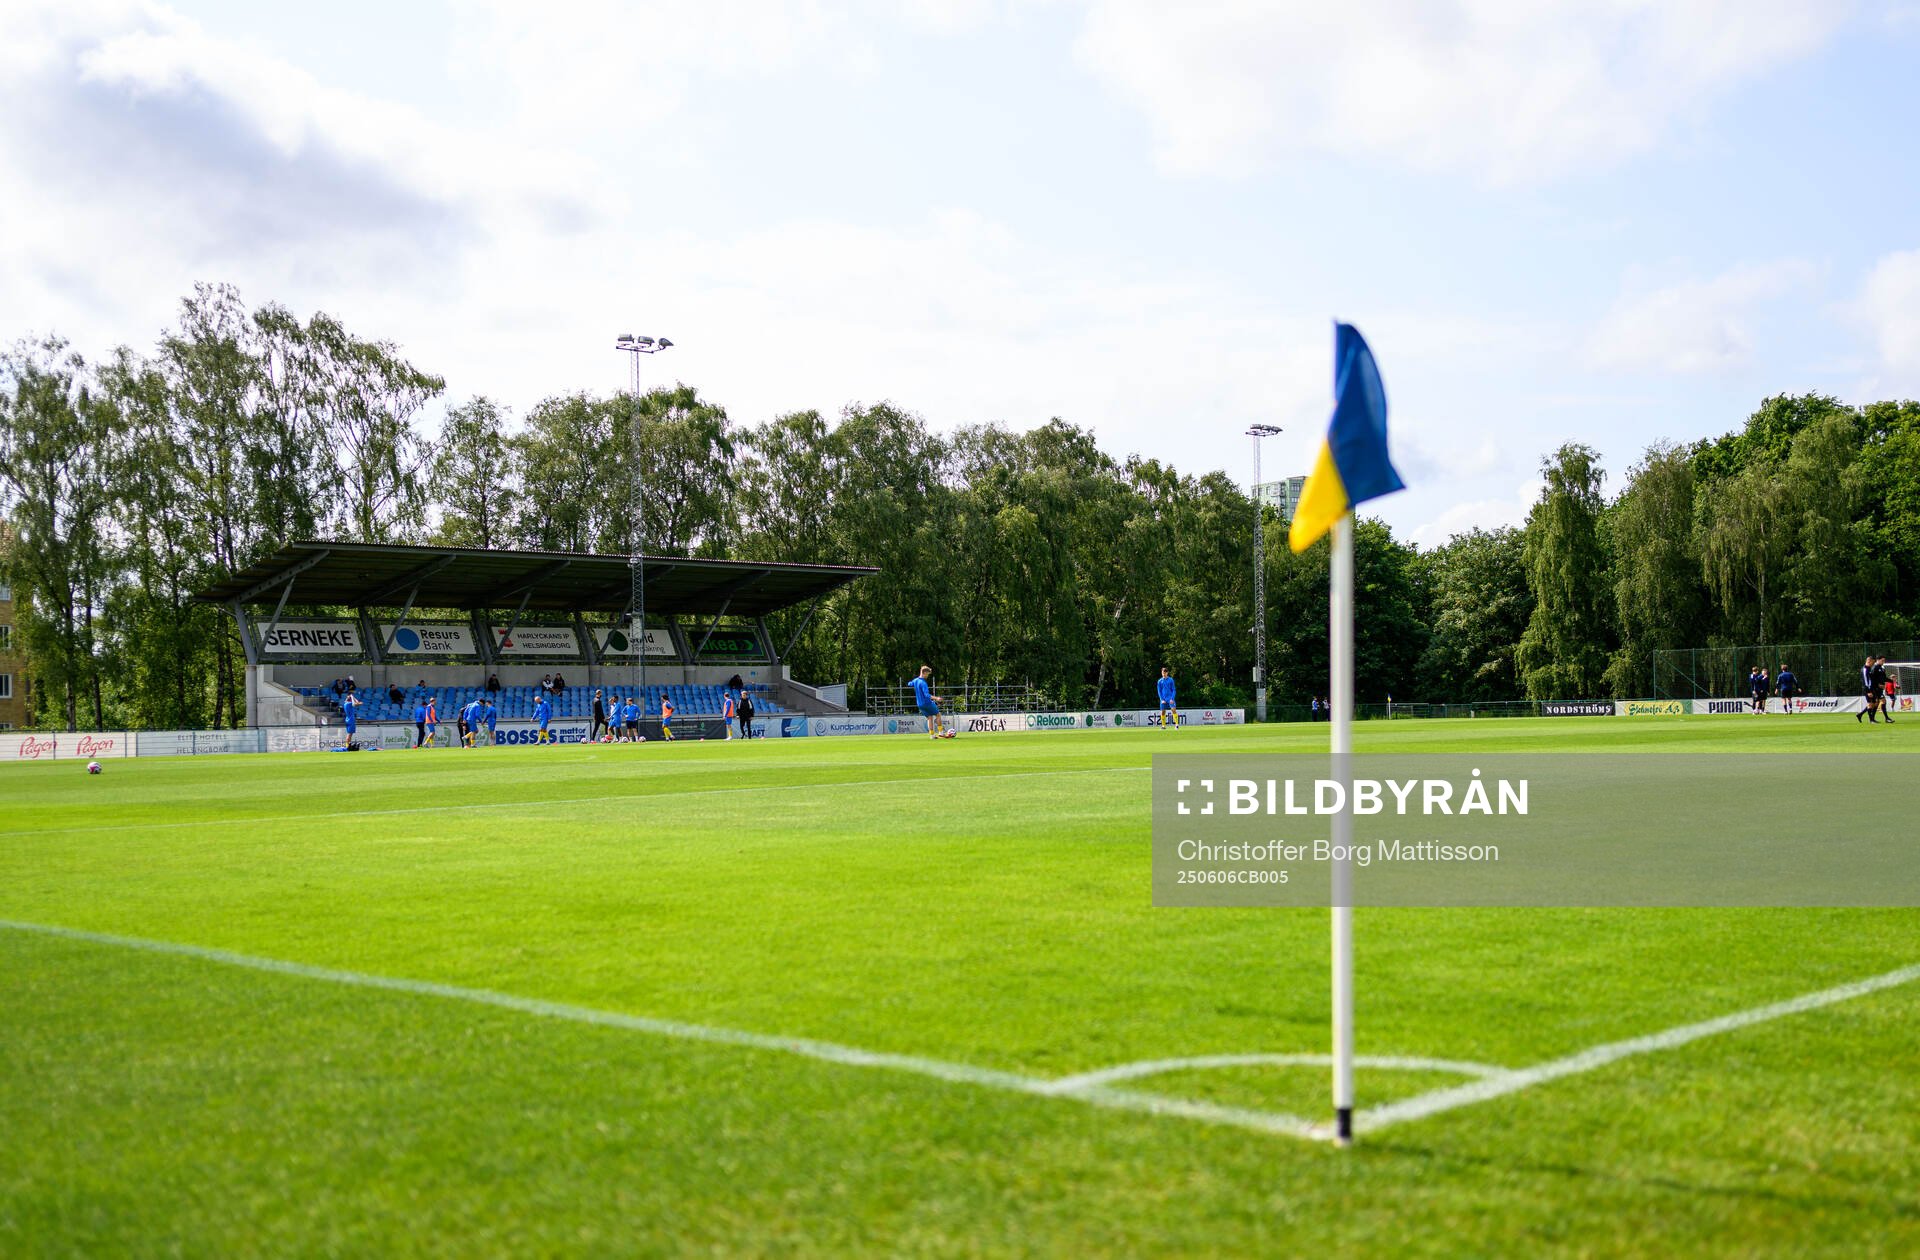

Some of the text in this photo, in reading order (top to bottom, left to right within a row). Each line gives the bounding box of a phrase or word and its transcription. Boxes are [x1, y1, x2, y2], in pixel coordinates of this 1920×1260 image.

[266, 629, 353, 646] SERNEKE
[420, 629, 460, 640] Resurs
[423, 640, 452, 651] Bank
[1546, 703, 1611, 714] NORDSTRÖMS
[1708, 701, 1743, 714] PUMA
[1036, 714, 1075, 726] Rekomo
[495, 729, 557, 745] BOSSS
